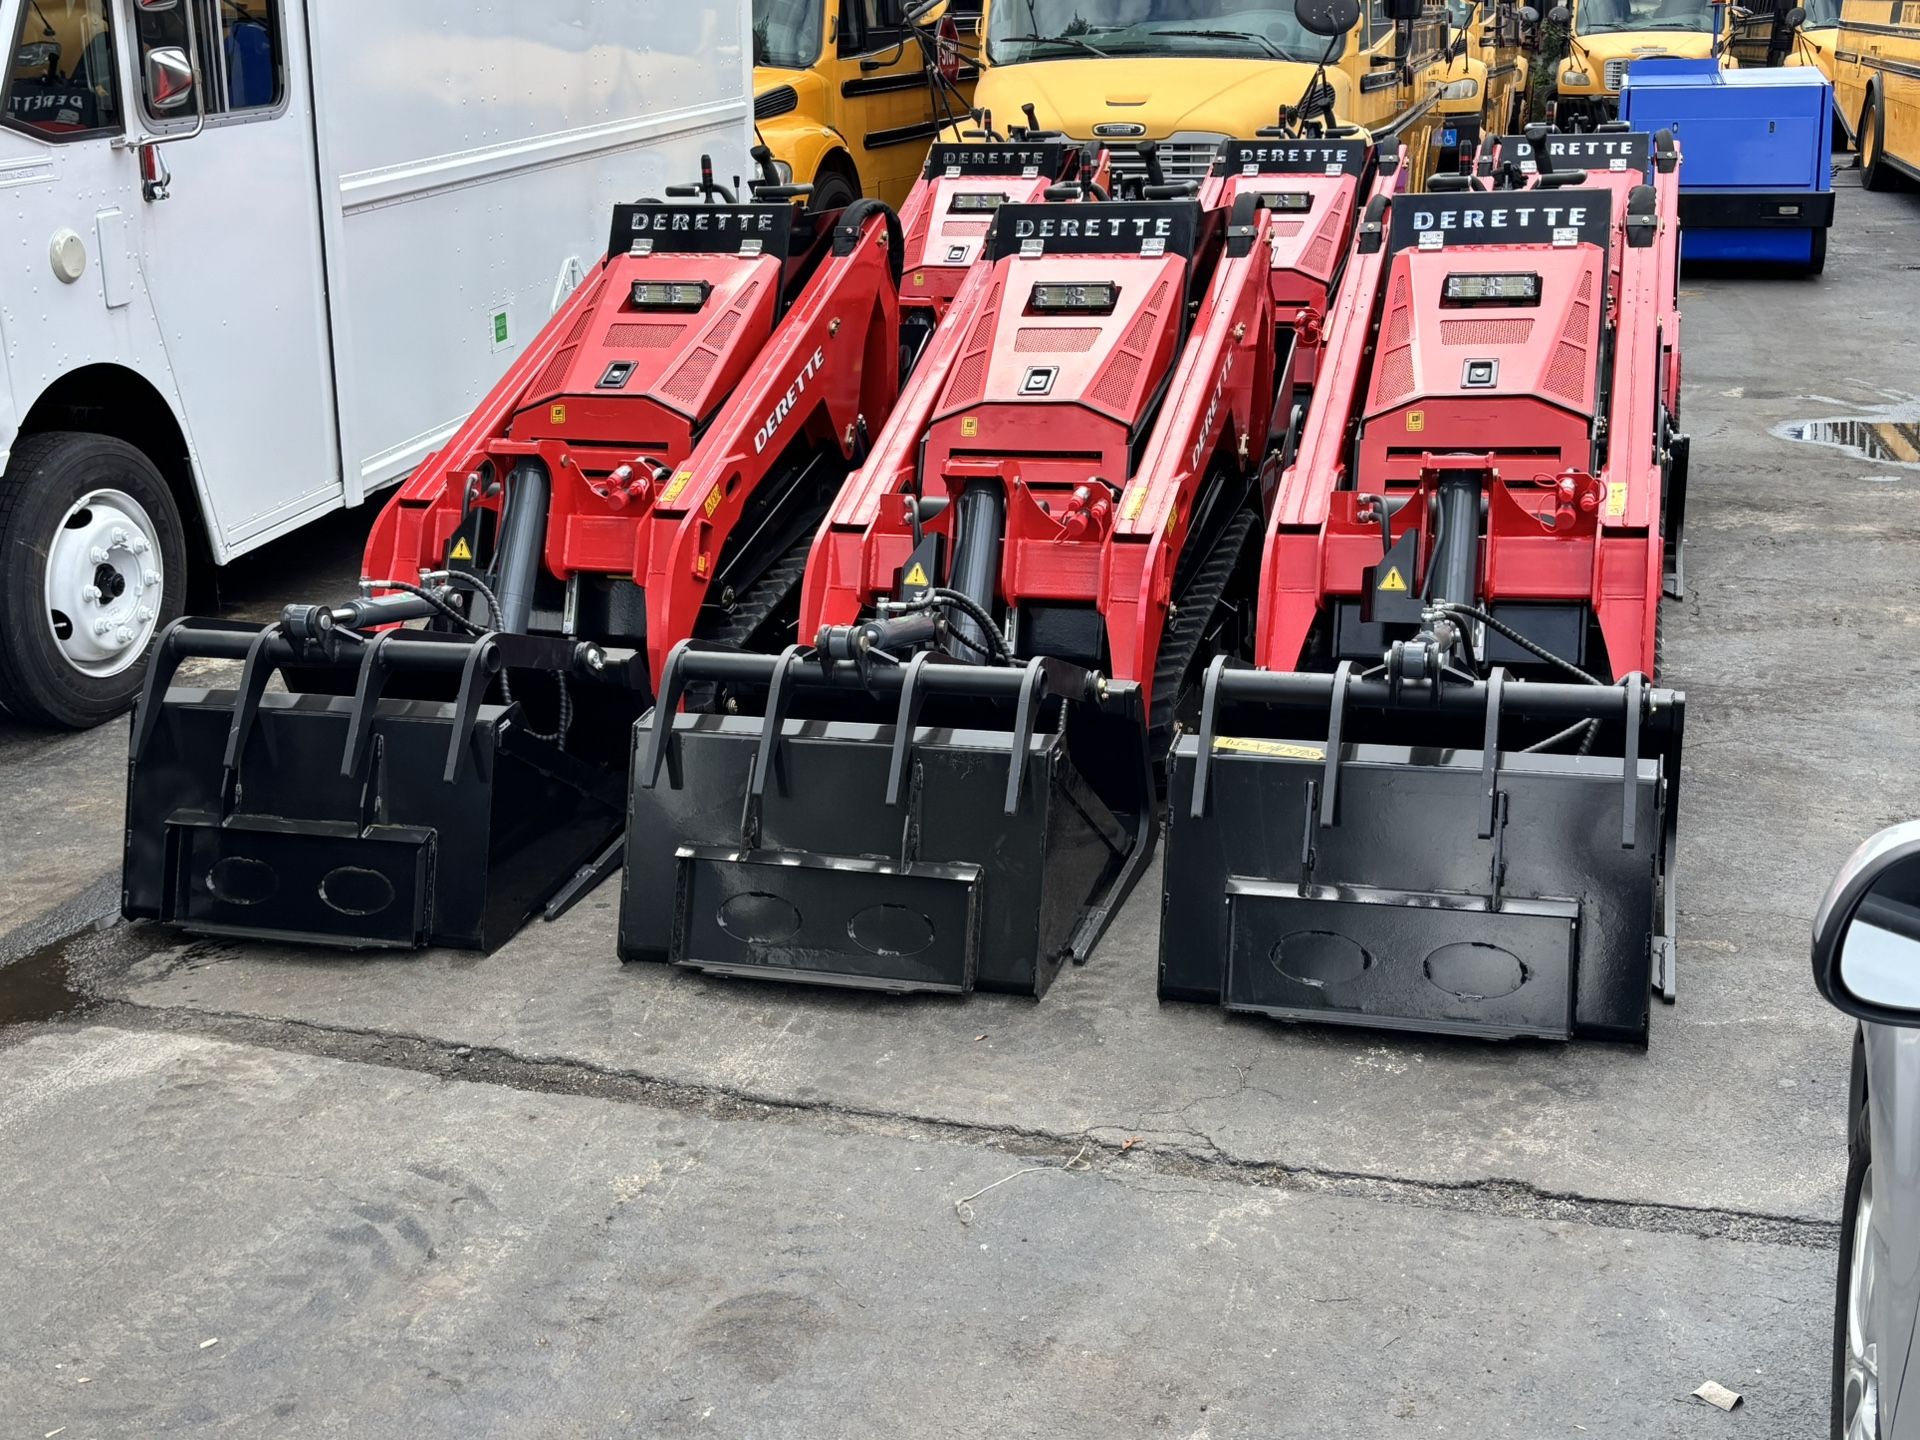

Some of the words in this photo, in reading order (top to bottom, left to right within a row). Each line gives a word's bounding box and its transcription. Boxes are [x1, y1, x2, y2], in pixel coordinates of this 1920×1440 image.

[943, 151, 1044, 165] DERETTE
[1240, 148, 1348, 162] DERETTE
[1517, 141, 1633, 156] DRETTE
[631, 212, 774, 231] DERETTE
[1015, 217, 1172, 238] DERETTE
[1413, 207, 1587, 231] DERETTE
[753, 345, 825, 455] DERETTE
[1191, 344, 1234, 472] DERETTE
